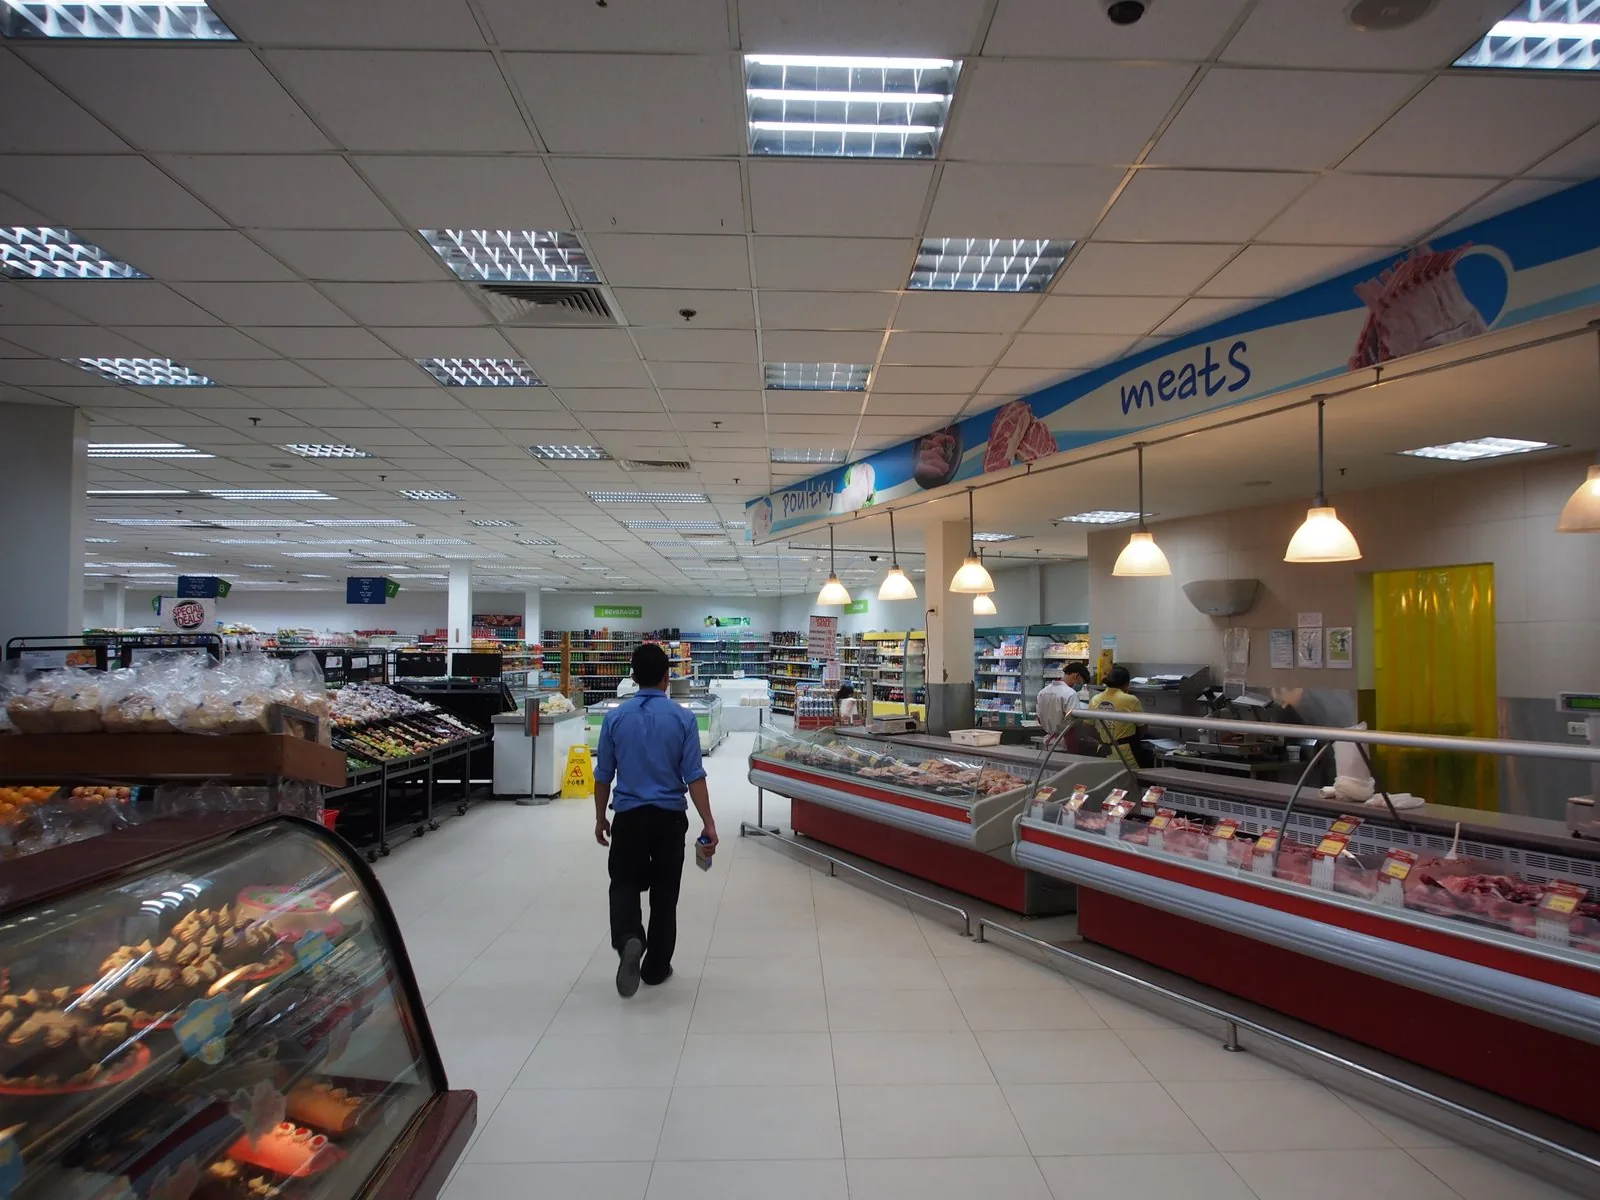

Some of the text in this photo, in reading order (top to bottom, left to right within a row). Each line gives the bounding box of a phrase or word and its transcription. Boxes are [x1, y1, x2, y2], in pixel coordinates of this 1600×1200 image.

[1121, 340, 1251, 415] meats
[782, 479, 834, 518] poultry
[219, 584, 225, 593] 8
[388, 584, 395, 593] 7
[172, 604, 202, 618] SPECIAL
[177, 613, 202, 625] DEALS
